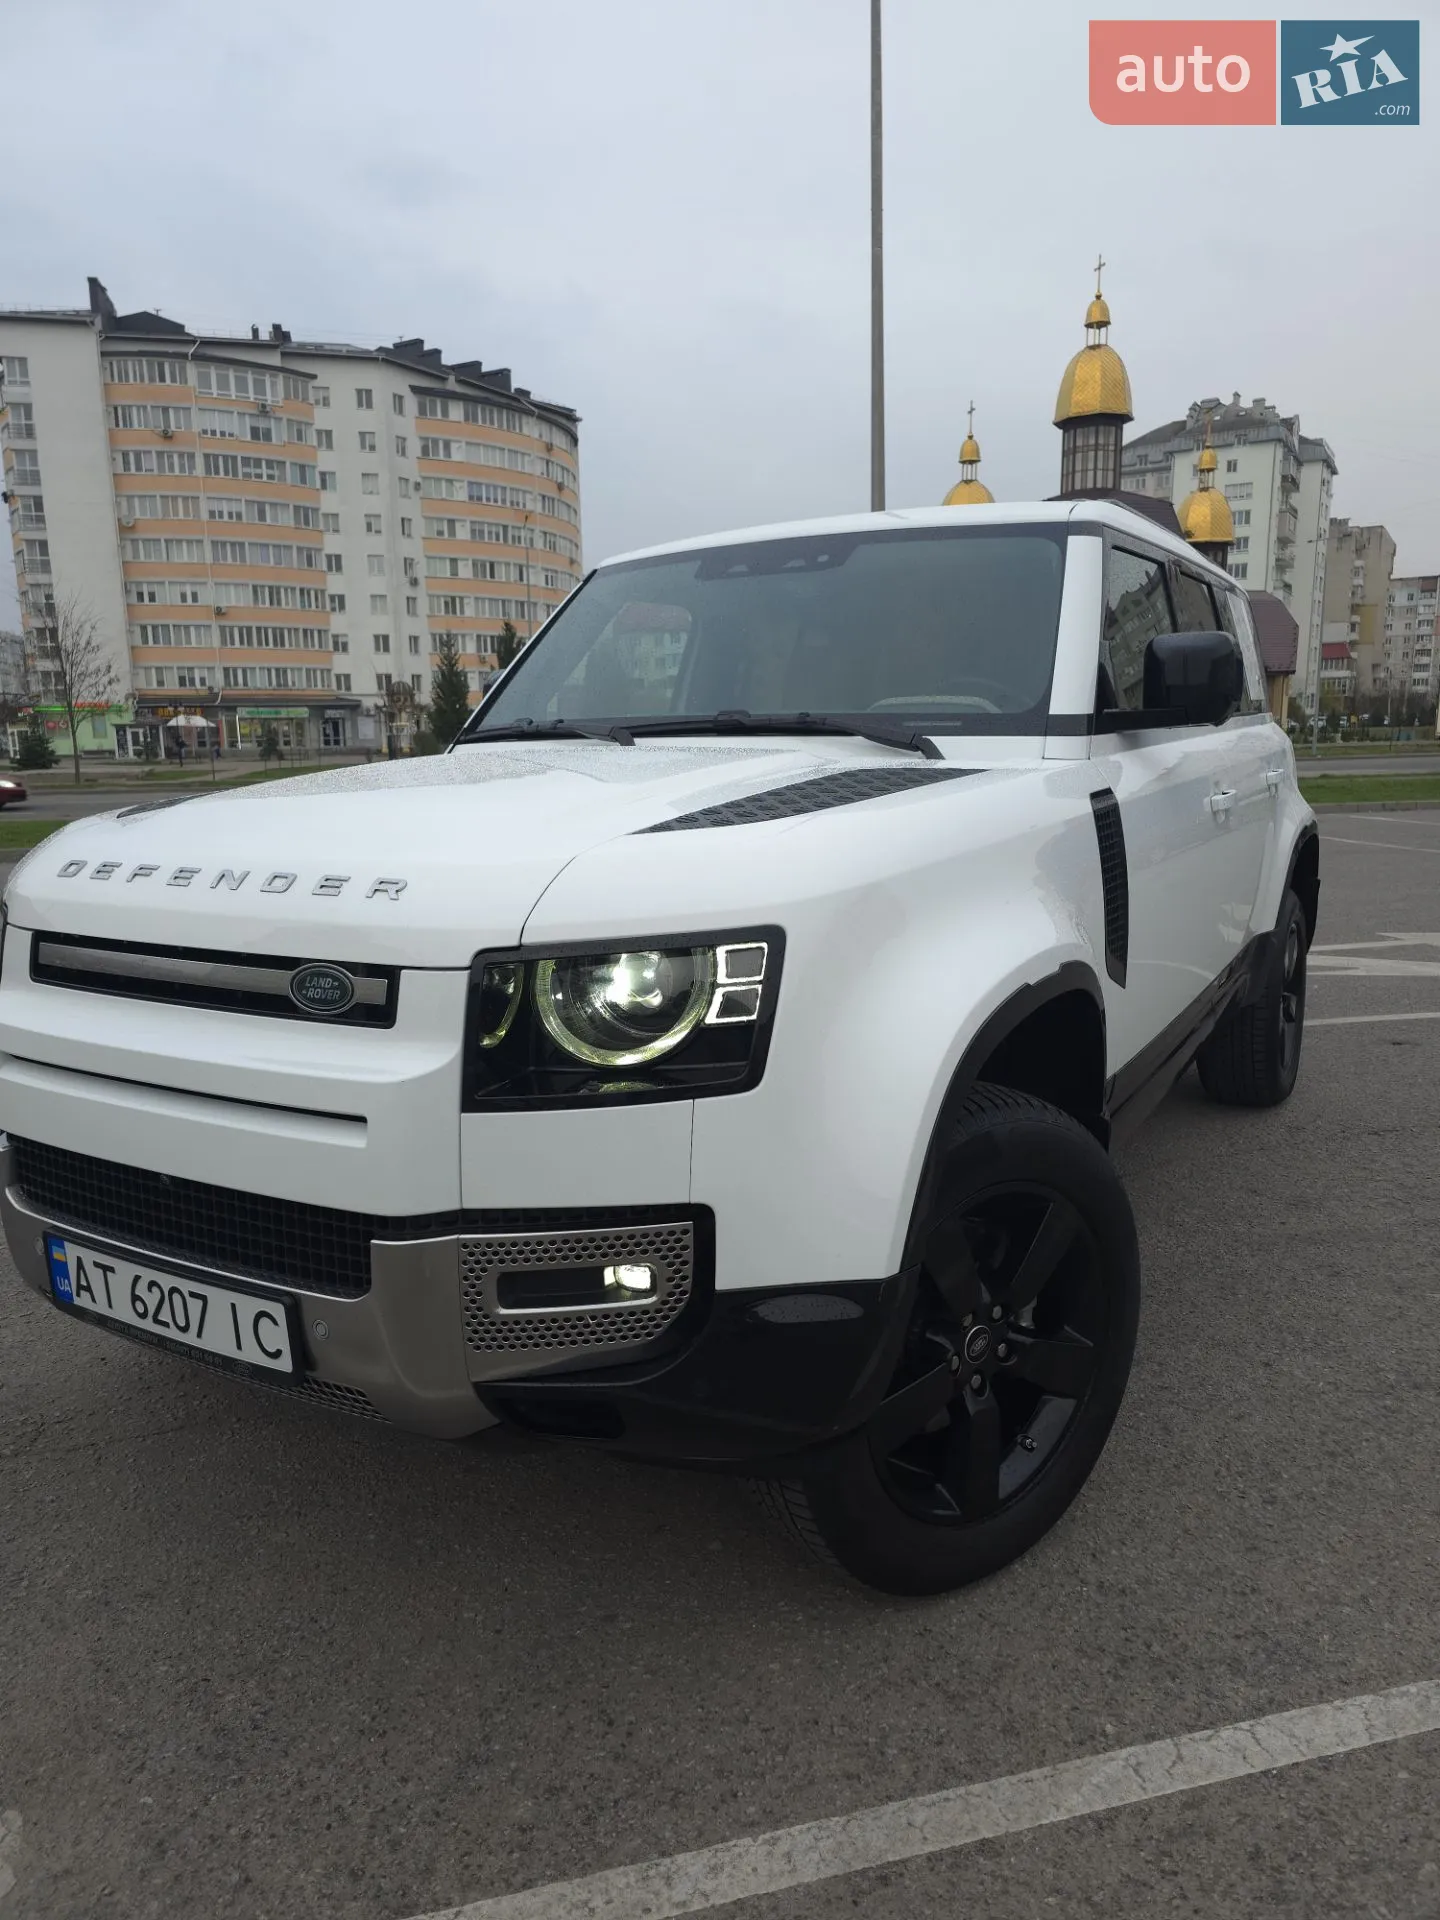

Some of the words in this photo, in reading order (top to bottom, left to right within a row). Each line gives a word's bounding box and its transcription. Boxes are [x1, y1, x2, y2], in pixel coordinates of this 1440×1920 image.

[56, 859, 408, 901] DEFENDER
[56, 1275, 72, 1293] UA
[75, 1255, 117, 1310] AT
[130, 1274, 209, 1339] 6207
[230, 1302, 283, 1360] IC
